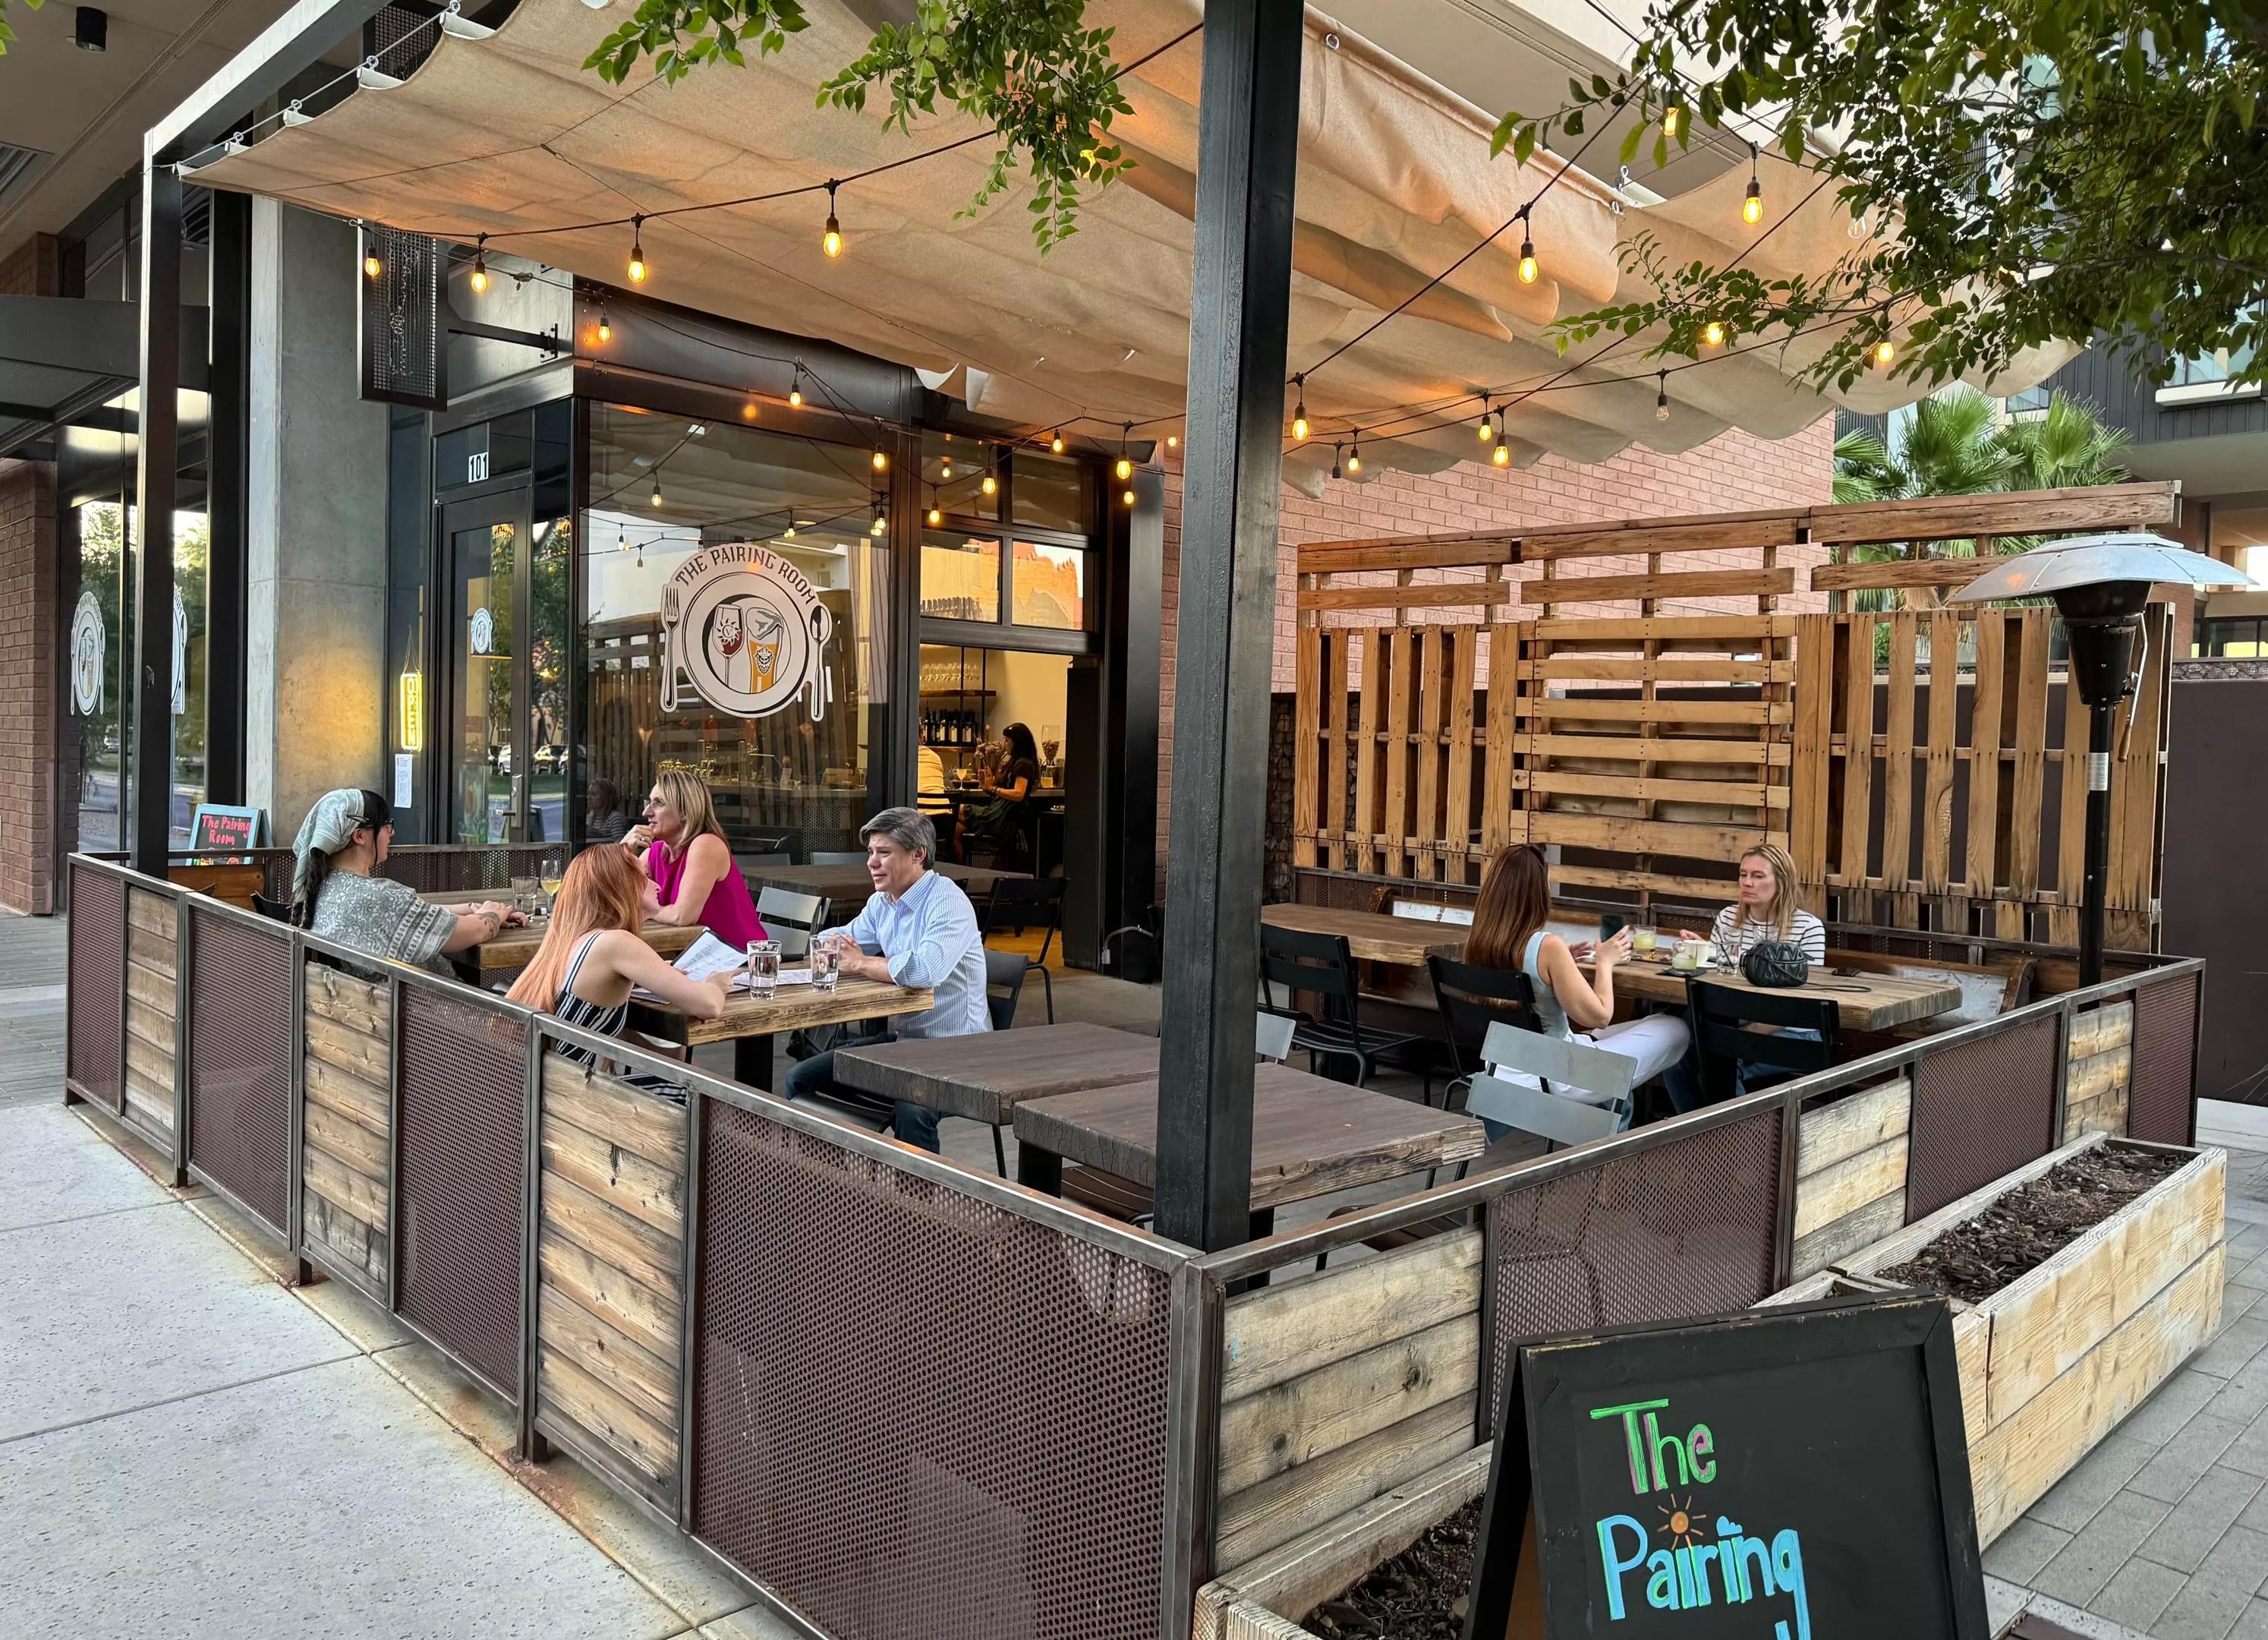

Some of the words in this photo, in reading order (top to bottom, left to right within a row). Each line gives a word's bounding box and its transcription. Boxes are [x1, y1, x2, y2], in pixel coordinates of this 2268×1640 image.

[471, 454, 487, 481] 101
[676, 555, 707, 586] THE
[710, 546, 776, 569] PAIRING
[777, 562, 816, 605] ROOM
[202, 815, 219, 829] The
[221, 816, 251, 839] Pairing
[209, 829, 235, 845] Room
[1589, 1398, 1717, 1495] The
[1596, 1514, 1811, 1640] Pairing
